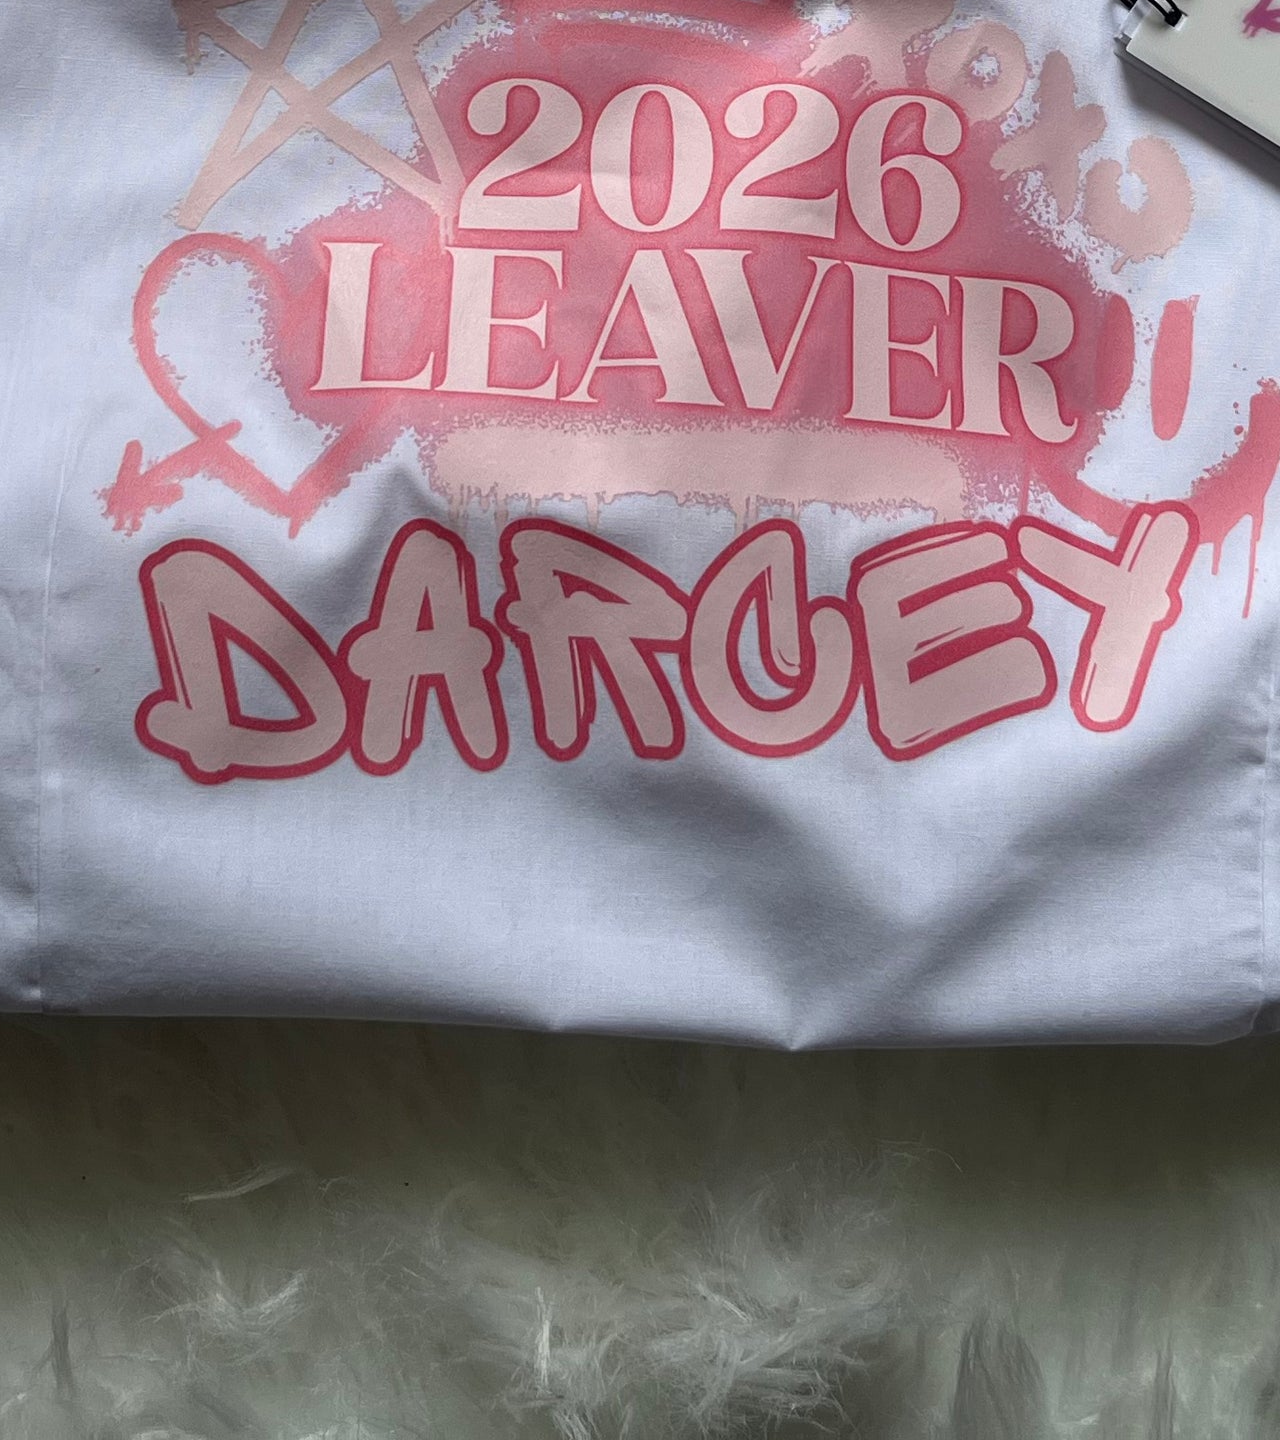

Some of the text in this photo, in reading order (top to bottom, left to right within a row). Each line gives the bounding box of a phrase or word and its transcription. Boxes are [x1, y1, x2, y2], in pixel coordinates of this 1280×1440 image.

[457, 77, 965, 250] 2026
[309, 241, 1079, 442] LEAVER
[133, 501, 1201, 785] DARCEY
